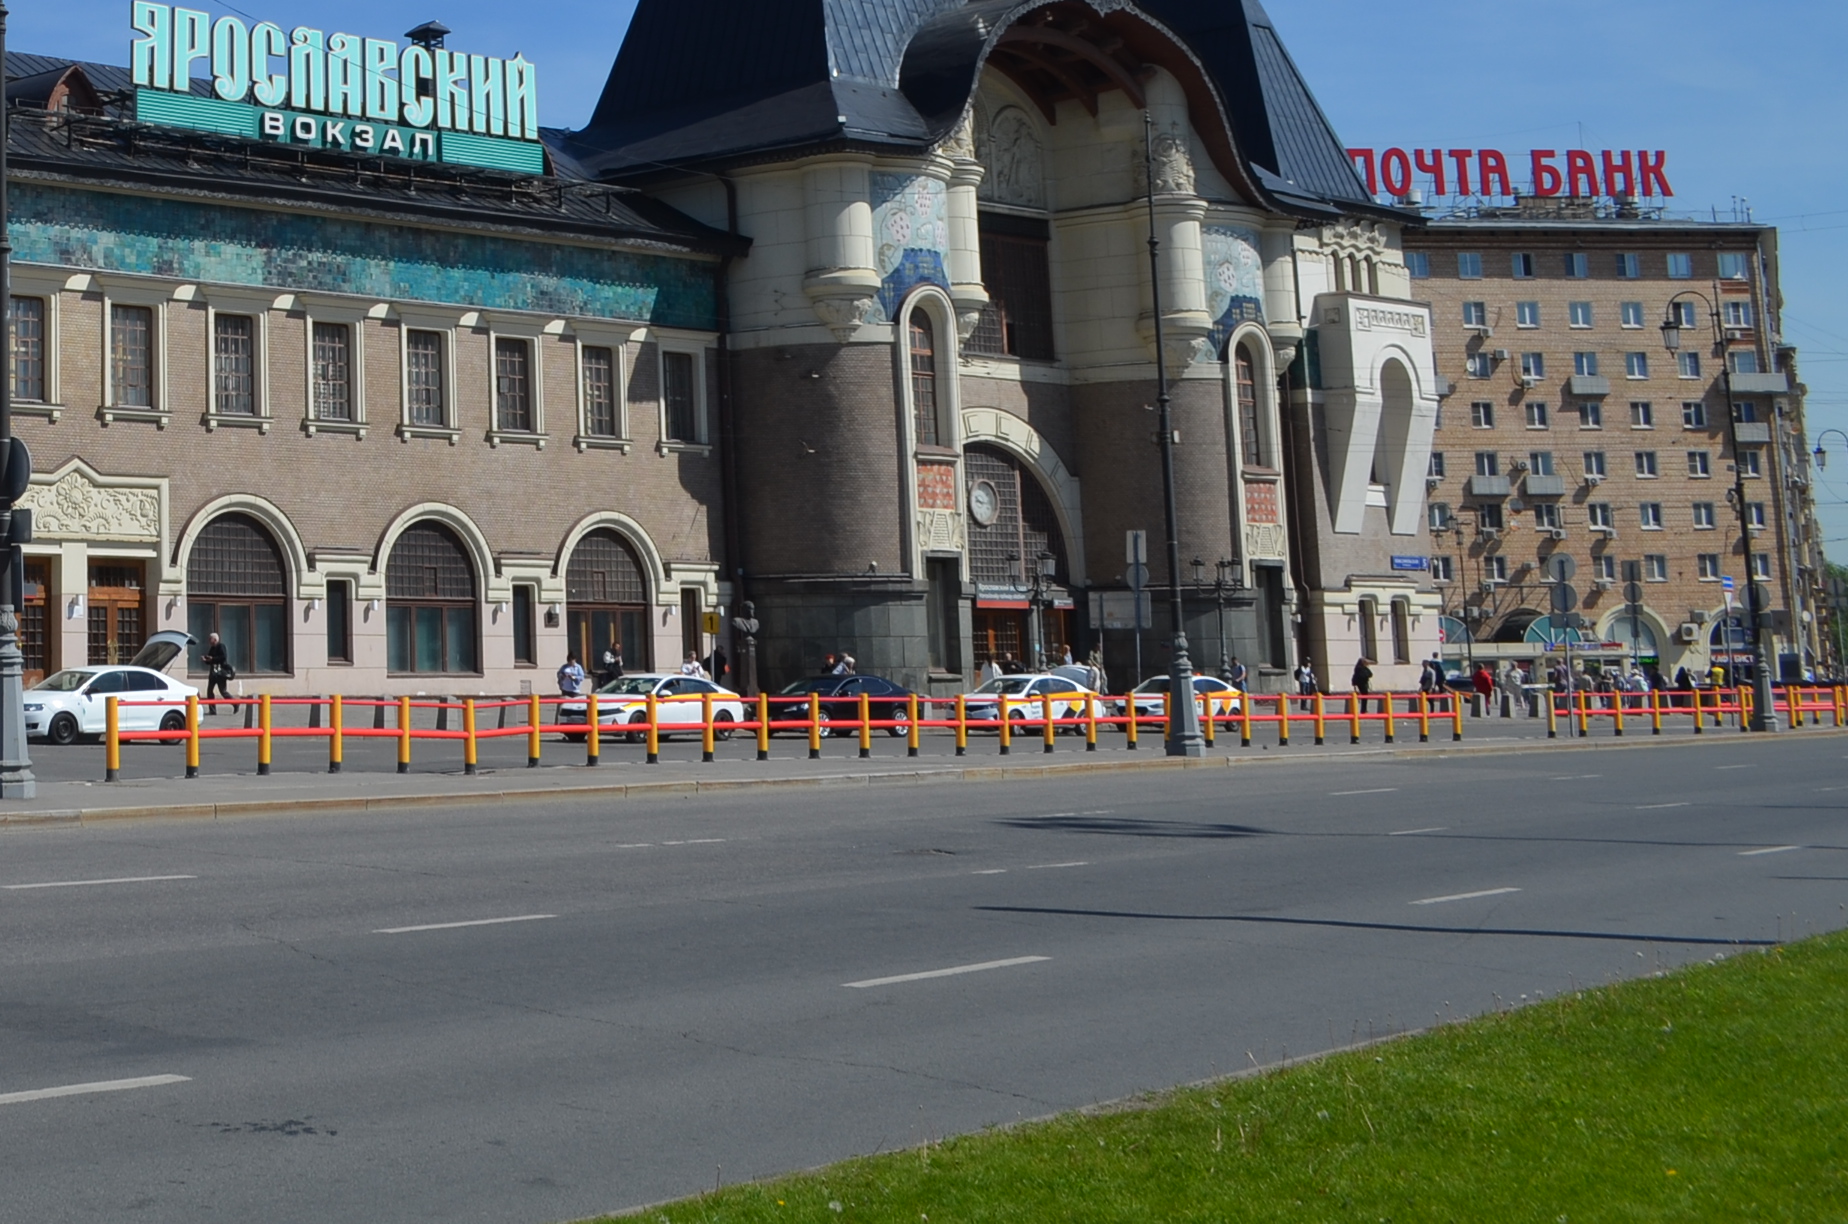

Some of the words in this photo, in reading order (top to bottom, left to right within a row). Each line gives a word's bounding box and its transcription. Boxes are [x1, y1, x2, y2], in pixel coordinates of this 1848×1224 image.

[130, 0, 538, 140] ЯРОСЛАВСКИЙ
[263, 110, 436, 157] ВОКЗАЛ
[1346, 147, 1512, 196] ПОЧТА
[1530, 149, 1674, 197] БАНК
[708, 615, 714, 631] 1
